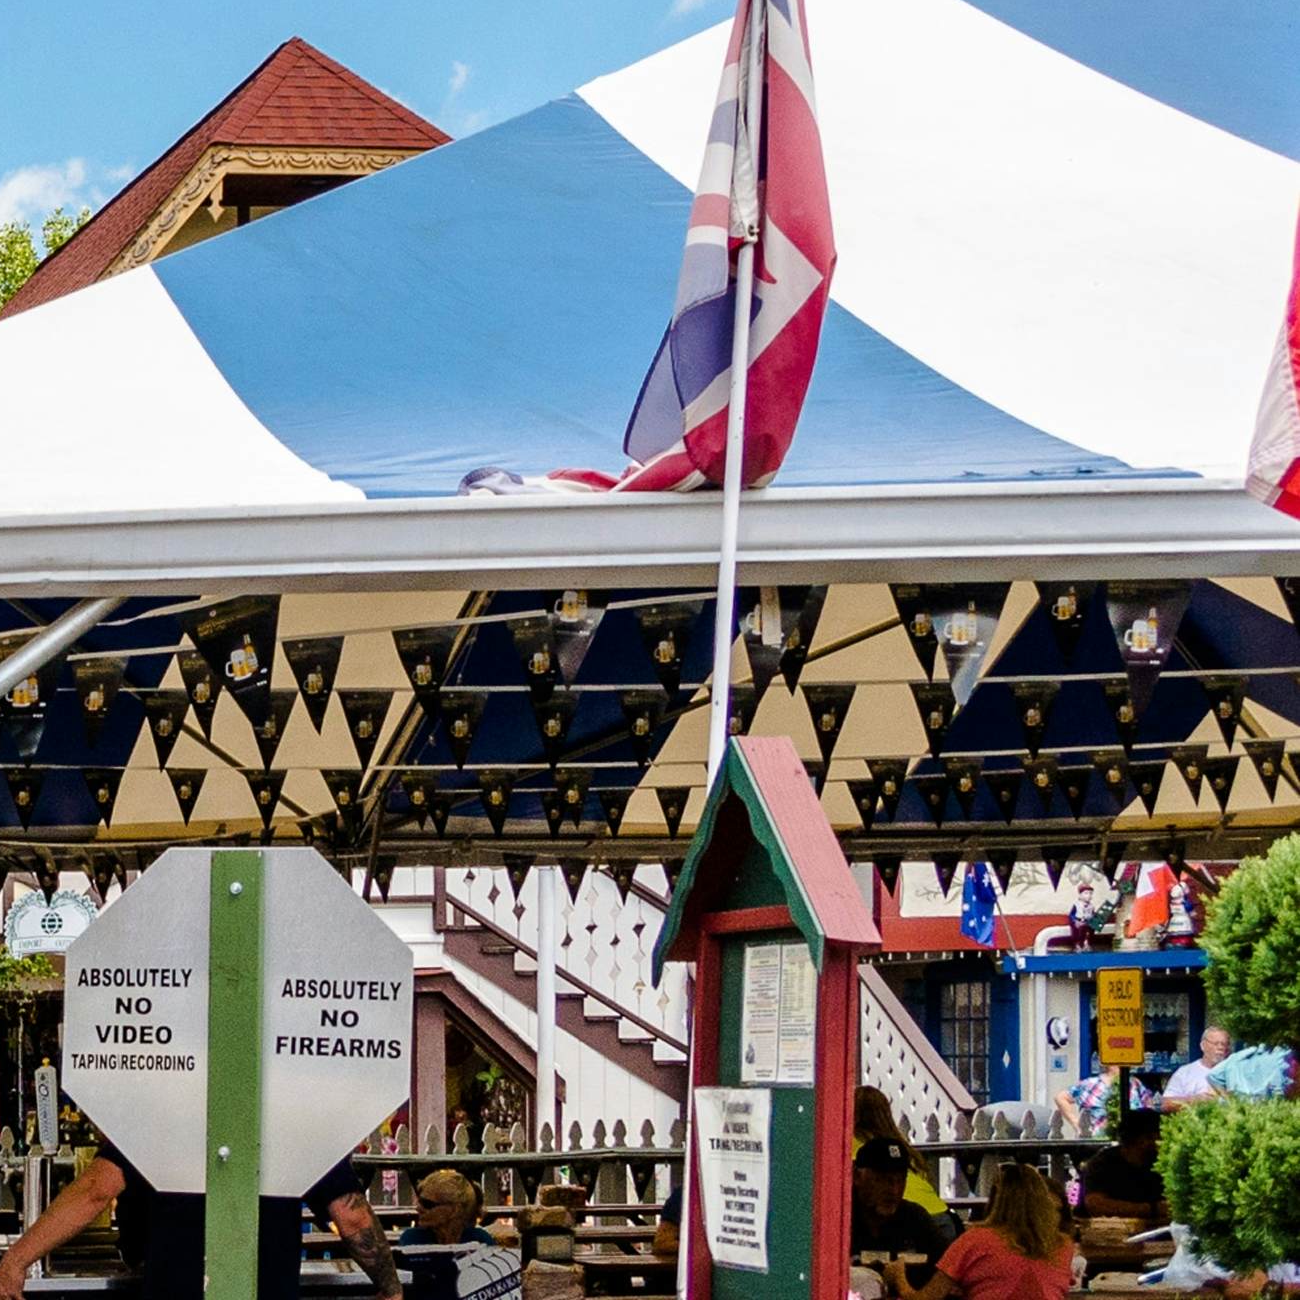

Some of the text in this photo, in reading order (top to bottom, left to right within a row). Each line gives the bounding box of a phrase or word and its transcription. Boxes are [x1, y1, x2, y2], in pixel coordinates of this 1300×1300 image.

[78, 968, 193, 988] ABSOLUTELY
[282, 979, 402, 1001] ABSOLUTELY
[115, 996, 152, 1015] NO
[320, 1010, 359, 1028] NO
[96, 1025, 172, 1045] VIDEO
[275, 1036, 402, 1060] FIREARMS
